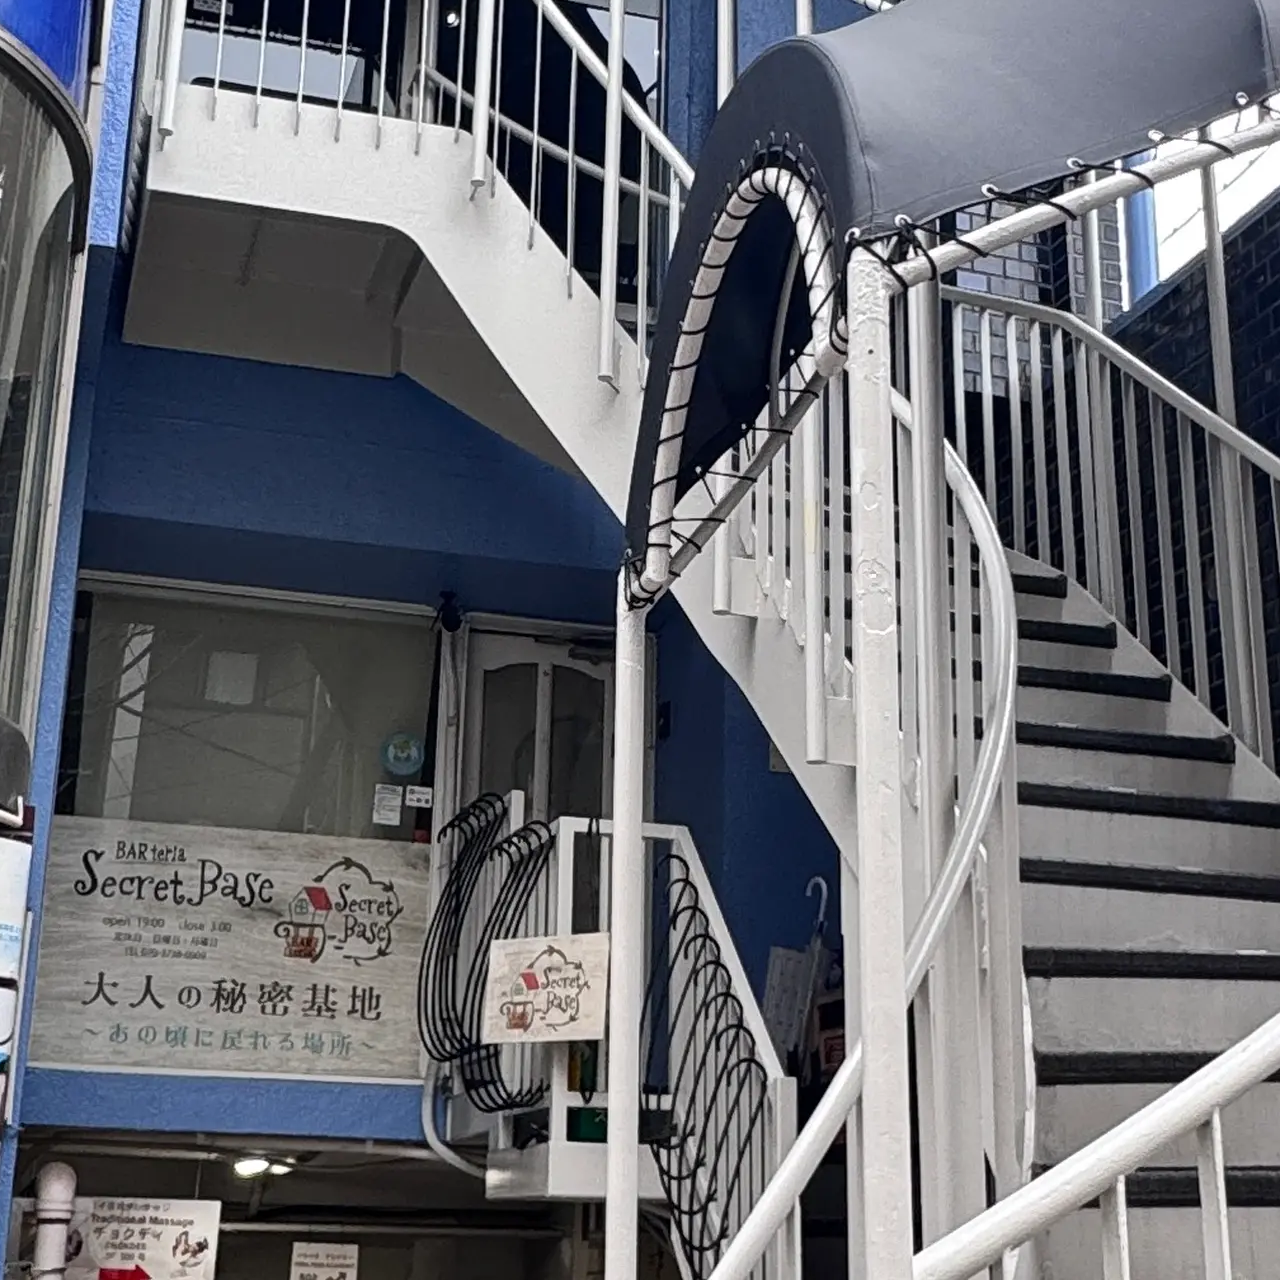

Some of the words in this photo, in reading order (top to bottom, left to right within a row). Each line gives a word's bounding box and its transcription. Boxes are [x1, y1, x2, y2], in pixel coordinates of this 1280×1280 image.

[74, 849, 186, 905] Secret
[187, 859, 274, 908] Base
[335, 883, 393, 916] Secret
[338, 914, 386, 944] Base
[541, 967, 580, 989] Secret
[81, 971, 382, 1021] 大人の秘密基地
